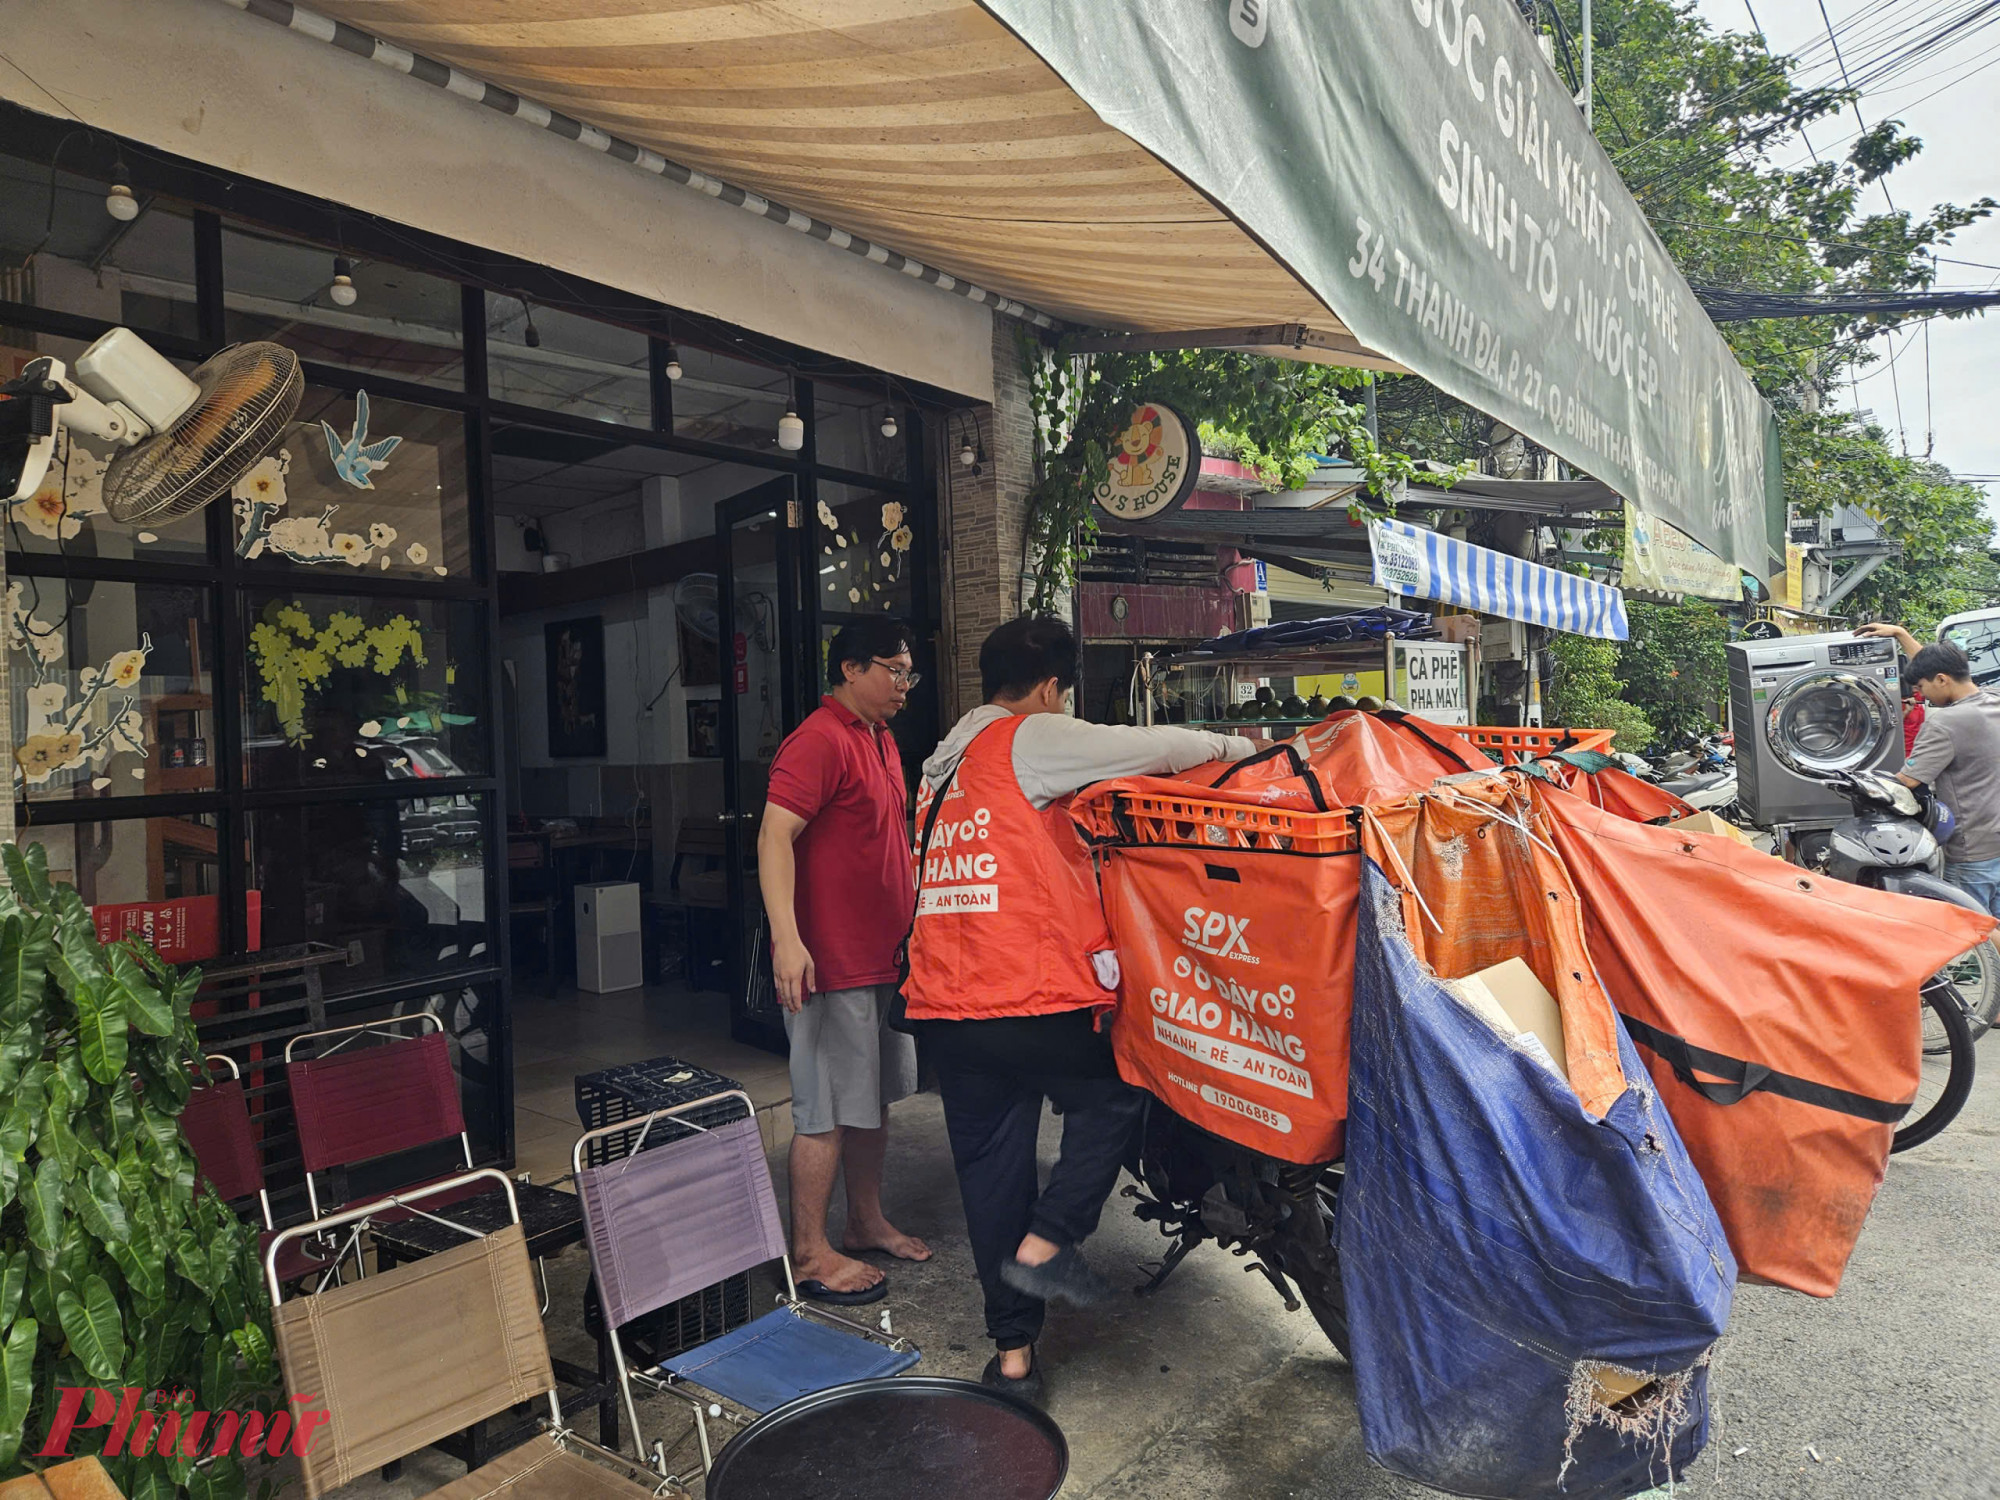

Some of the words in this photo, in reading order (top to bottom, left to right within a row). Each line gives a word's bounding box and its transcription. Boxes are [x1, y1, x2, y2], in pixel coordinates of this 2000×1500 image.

[1493, 55, 1550, 190] GIẢI
[1556, 139, 1611, 265] KHÁT
[1438, 119, 1517, 273] SINH
[1524, 213, 1561, 312] TỐ
[1575, 278, 1634, 389] NƯỚC
[1349, 216, 1386, 292] 34
[1394, 248, 1475, 358] THANH
[1567, 390, 1600, 453] BÌNH
[1133, 455, 1181, 512] HOUSE
[1409, 648, 1428, 680] CÀ
[1431, 650, 1458, 680] PHÊ
[1240, 685, 1253, 695] 32
[1411, 688, 1433, 709] PHA
[1436, 680, 1459, 709] MÁY
[925, 850, 998, 883] HÀNG
[936, 893, 952, 908] AN
[954, 890, 991, 906] TOÀN
[1182, 906, 1250, 957] SPX
[1229, 951, 1260, 965] EXPRESS
[1150, 987, 1222, 1029] GIAO
[1229, 1009, 1306, 1062] HÀNG
[1157, 1024, 1197, 1053] NHANH
[1210, 1045, 1229, 1064] RẺ
[1243, 1057, 1265, 1077] AN
[1269, 1063, 1307, 1090] TOÀN
[1168, 1071, 1199, 1094] HOTLINE
[1214, 1091, 1278, 1127] 19006885
